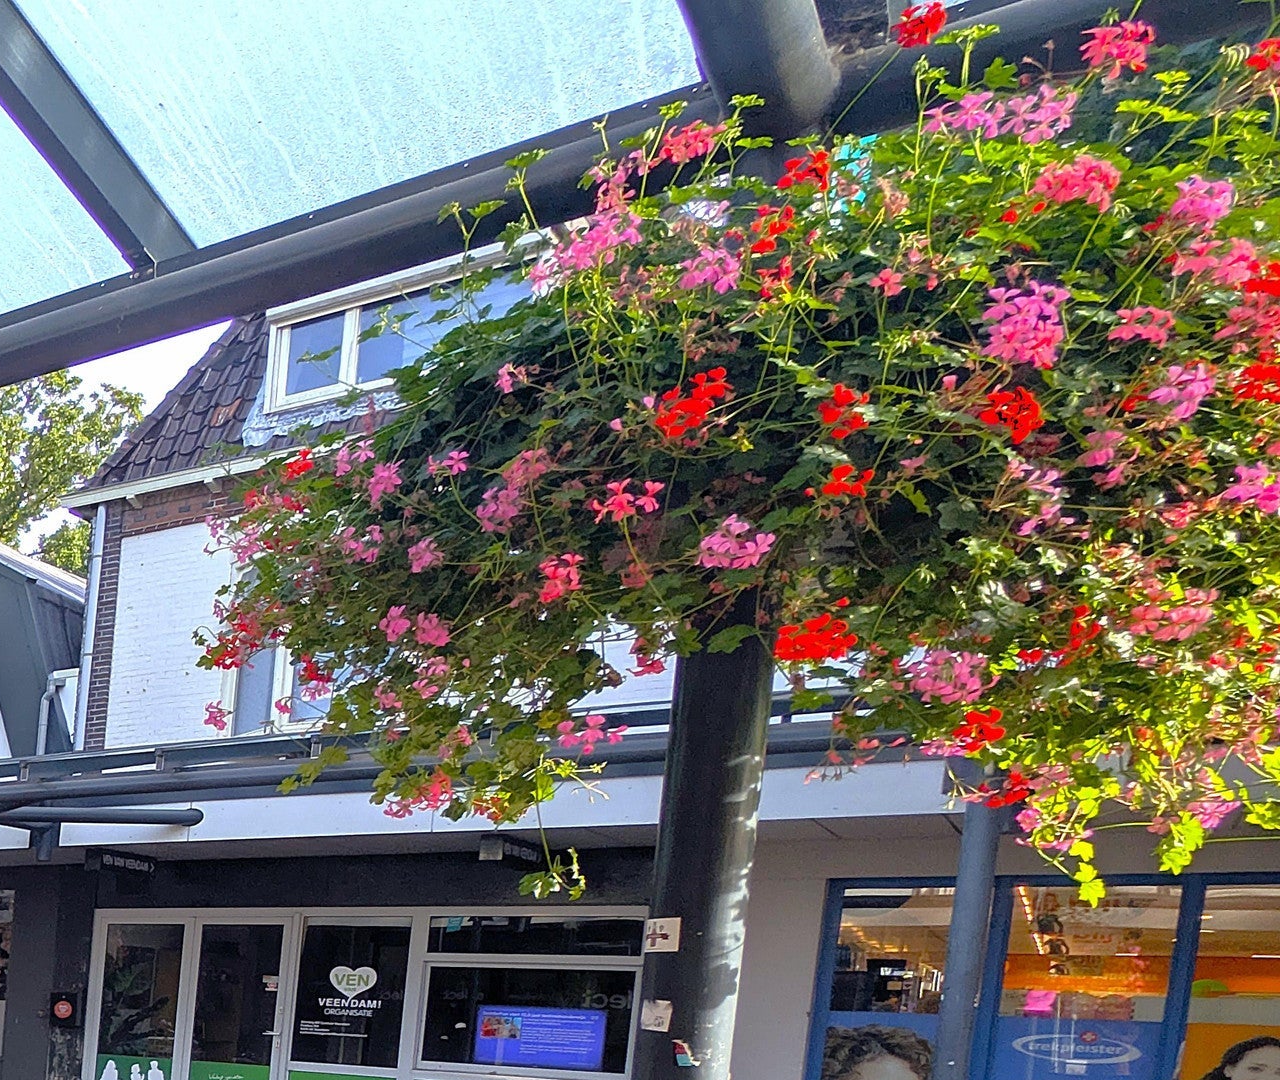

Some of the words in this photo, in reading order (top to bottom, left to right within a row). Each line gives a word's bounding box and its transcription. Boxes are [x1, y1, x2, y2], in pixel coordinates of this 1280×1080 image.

[334, 973, 370, 987] VEN
[318, 998, 382, 1009] VEENDAM!
[324, 1008, 374, 1018] ORGANISATIE
[1028, 1041, 1125, 1055] trekpleister
